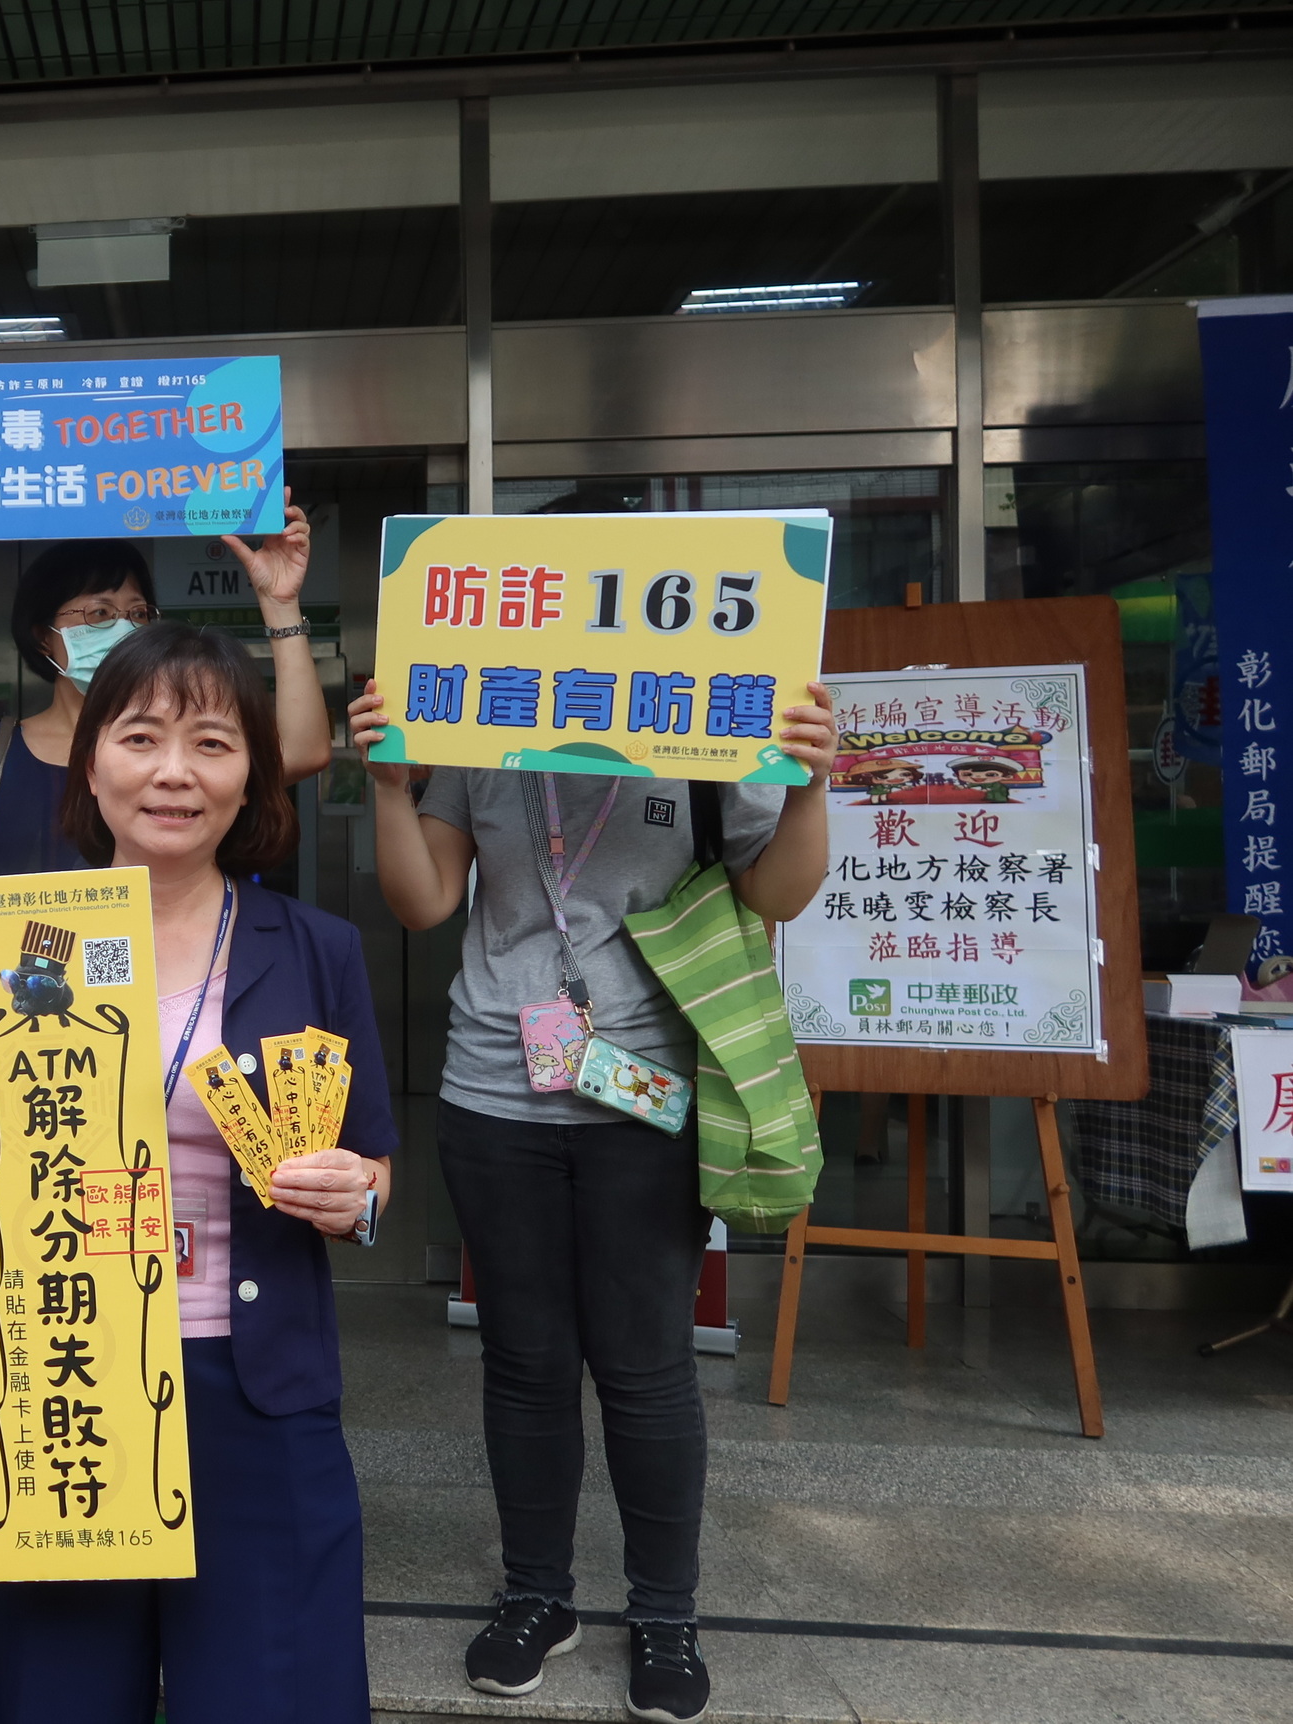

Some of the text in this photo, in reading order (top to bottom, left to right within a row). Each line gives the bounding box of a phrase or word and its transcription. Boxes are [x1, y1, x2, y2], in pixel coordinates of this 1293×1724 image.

[82, 377, 107, 389] 冷靜
[119, 376, 143, 388] 查證
[157, 375, 206, 387] 撥打165
[54, 401, 244, 446] TOGETHER
[95, 458, 265, 502] FOREVER
[188, 570, 239, 595] ATM
[423, 564, 760, 635] 防詐 165
[405, 664, 777, 739] 財產有防護
[845, 728, 1031, 748] Welcome
[654, 803, 667, 811] TH
[1237, 649, 1284, 962] 彰化郵局提醒您
[869, 808, 1005, 849] 歡迎
[824, 852, 1073, 884] 化地方檢察署
[17, 908, 48, 916] Changhua
[824, 891, 1061, 923] 張曉雯檢察長
[907, 982, 1019, 1005] 中華郵政
[900, 1006, 1027, 1017] Chunghwa Post Co., Ltd.
[86, 1182, 160, 1205] 歐熊師
[90, 1216, 163, 1238] 保平安
[4, 1269, 36, 1496] 請貼在金融卡上使用
[15, 1529, 153, 1550] 反詐騙專線165
